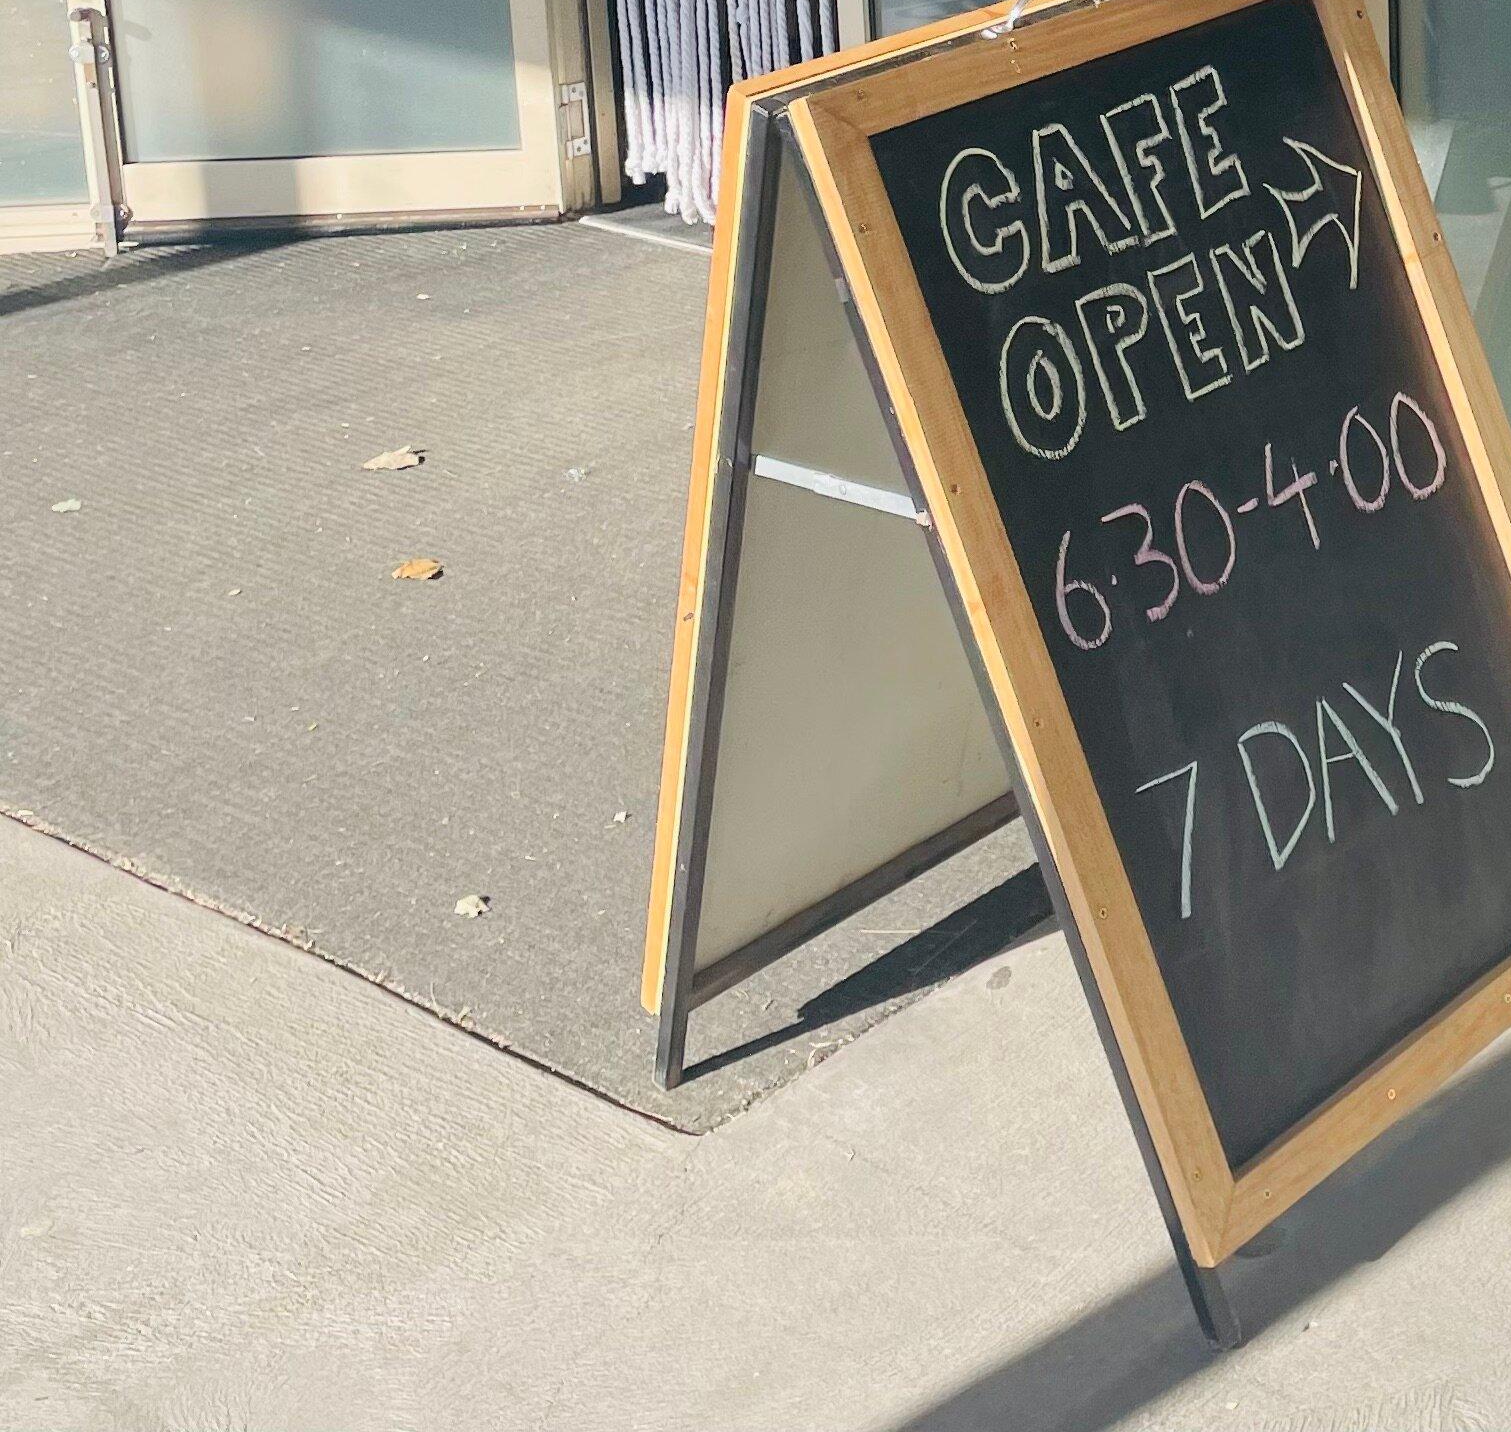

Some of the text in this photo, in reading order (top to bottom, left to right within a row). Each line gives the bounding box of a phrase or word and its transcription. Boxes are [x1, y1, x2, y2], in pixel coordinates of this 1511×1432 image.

[939, 65, 1251, 295] CAFE
[999, 229, 1306, 460] OPEN
[1135, 639, 1496, 920] 7 DAYS
